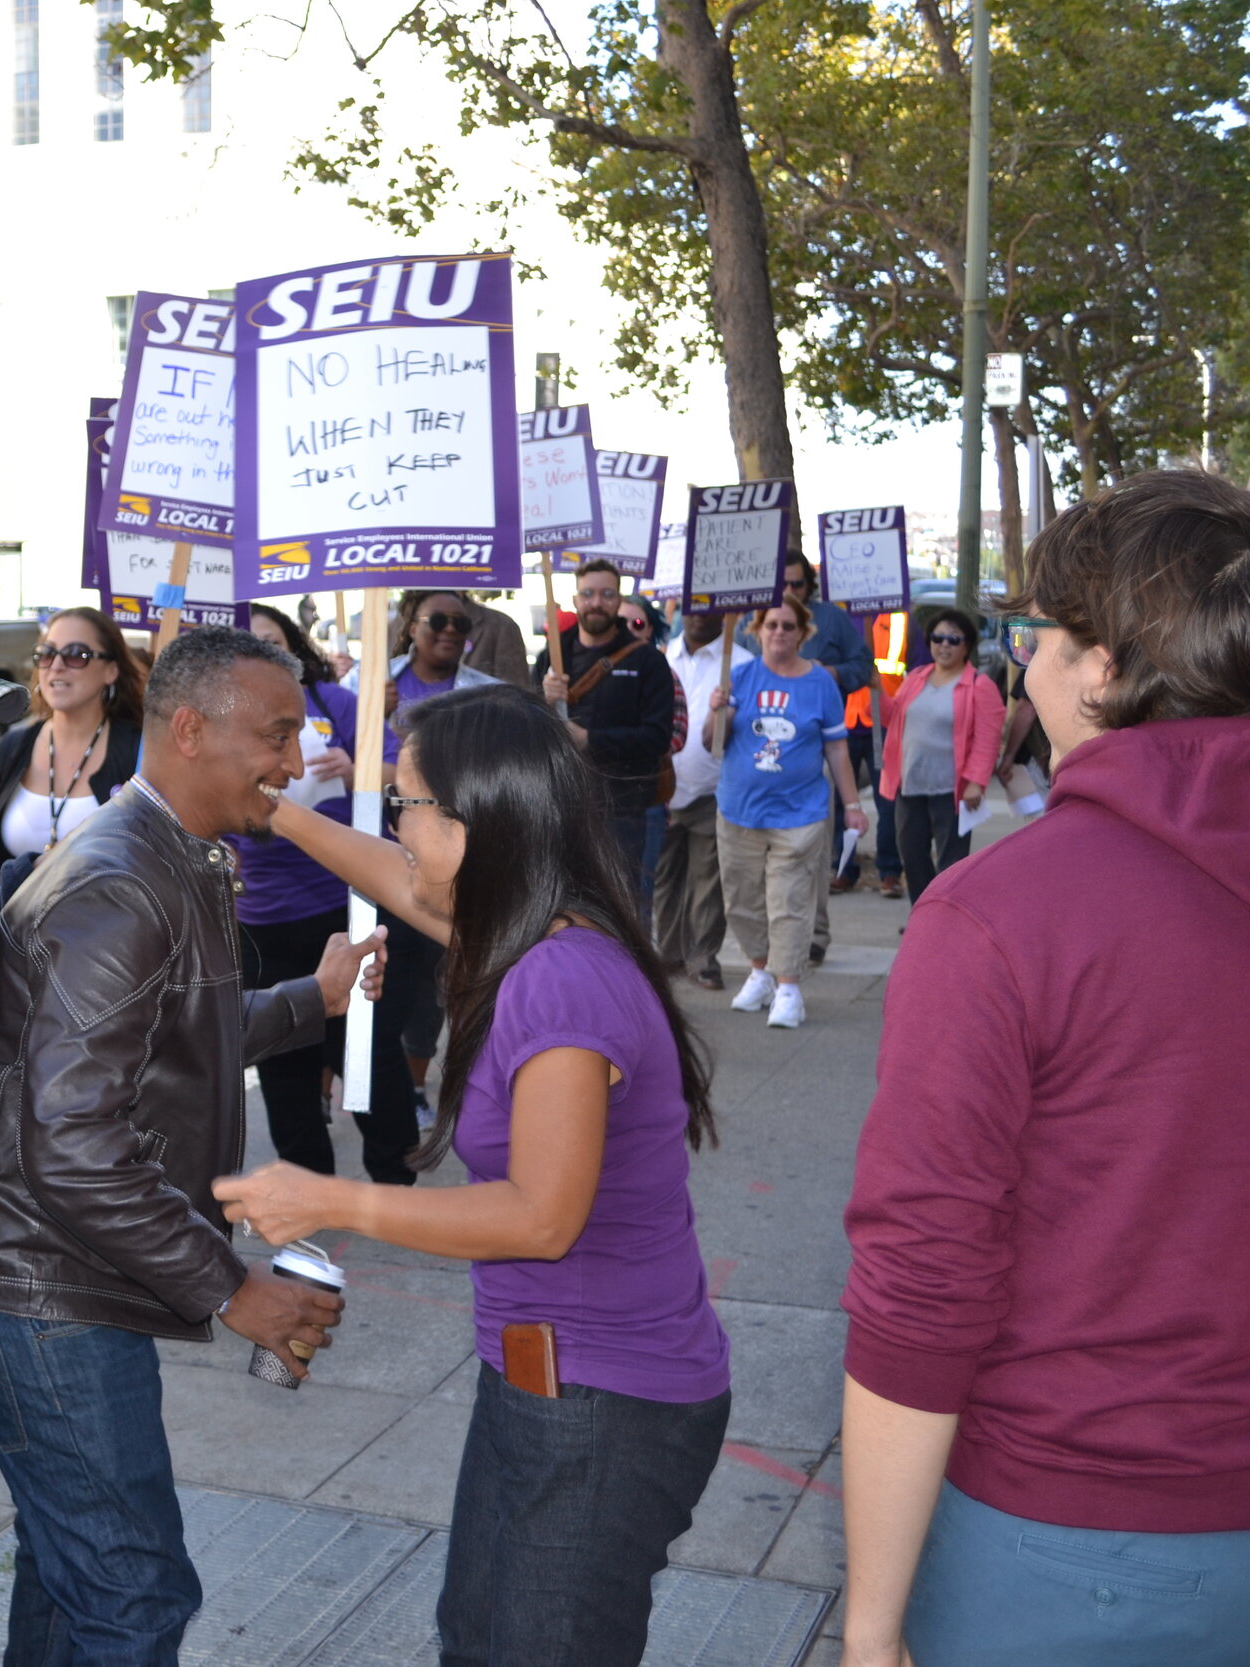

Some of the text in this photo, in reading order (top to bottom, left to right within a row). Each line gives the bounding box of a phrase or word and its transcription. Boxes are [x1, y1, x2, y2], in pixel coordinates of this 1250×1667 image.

[258, 260, 481, 340] SEIU
[158, 364, 216, 399] IF
[287, 352, 349, 398] NO
[135, 402, 167, 423] are
[177, 404, 212, 425] out
[520, 406, 579, 441] EIU
[133, 425, 220, 461] Something
[287, 409, 465, 457] WHEN THEY
[131, 459, 182, 489] wrong
[192, 464, 206, 479] in
[290, 452, 462, 488] JUST KEEP
[596, 452, 659, 478] EIU
[348, 484, 408, 511] CUT
[698, 482, 782, 513] SEIU
[115, 511, 149, 527] SEIU
[157, 508, 219, 531] LOCAL
[699, 515, 767, 538] PATIENT
[824, 508, 896, 535] SEIU
[324, 532, 494, 546] Service Employees International Union
[525, 530, 563, 546] LOCAL
[829, 536, 876, 561] CEO
[324, 543, 493, 568] LOCAL 1021
[257, 564, 310, 584] SEIU
[714, 594, 747, 606] LOCAL
[851, 600, 880, 612] LOCAL
[113, 612, 141, 623] SEIU
[147, 606, 198, 623] LOAL
[201, 611, 236, 626] 1021
